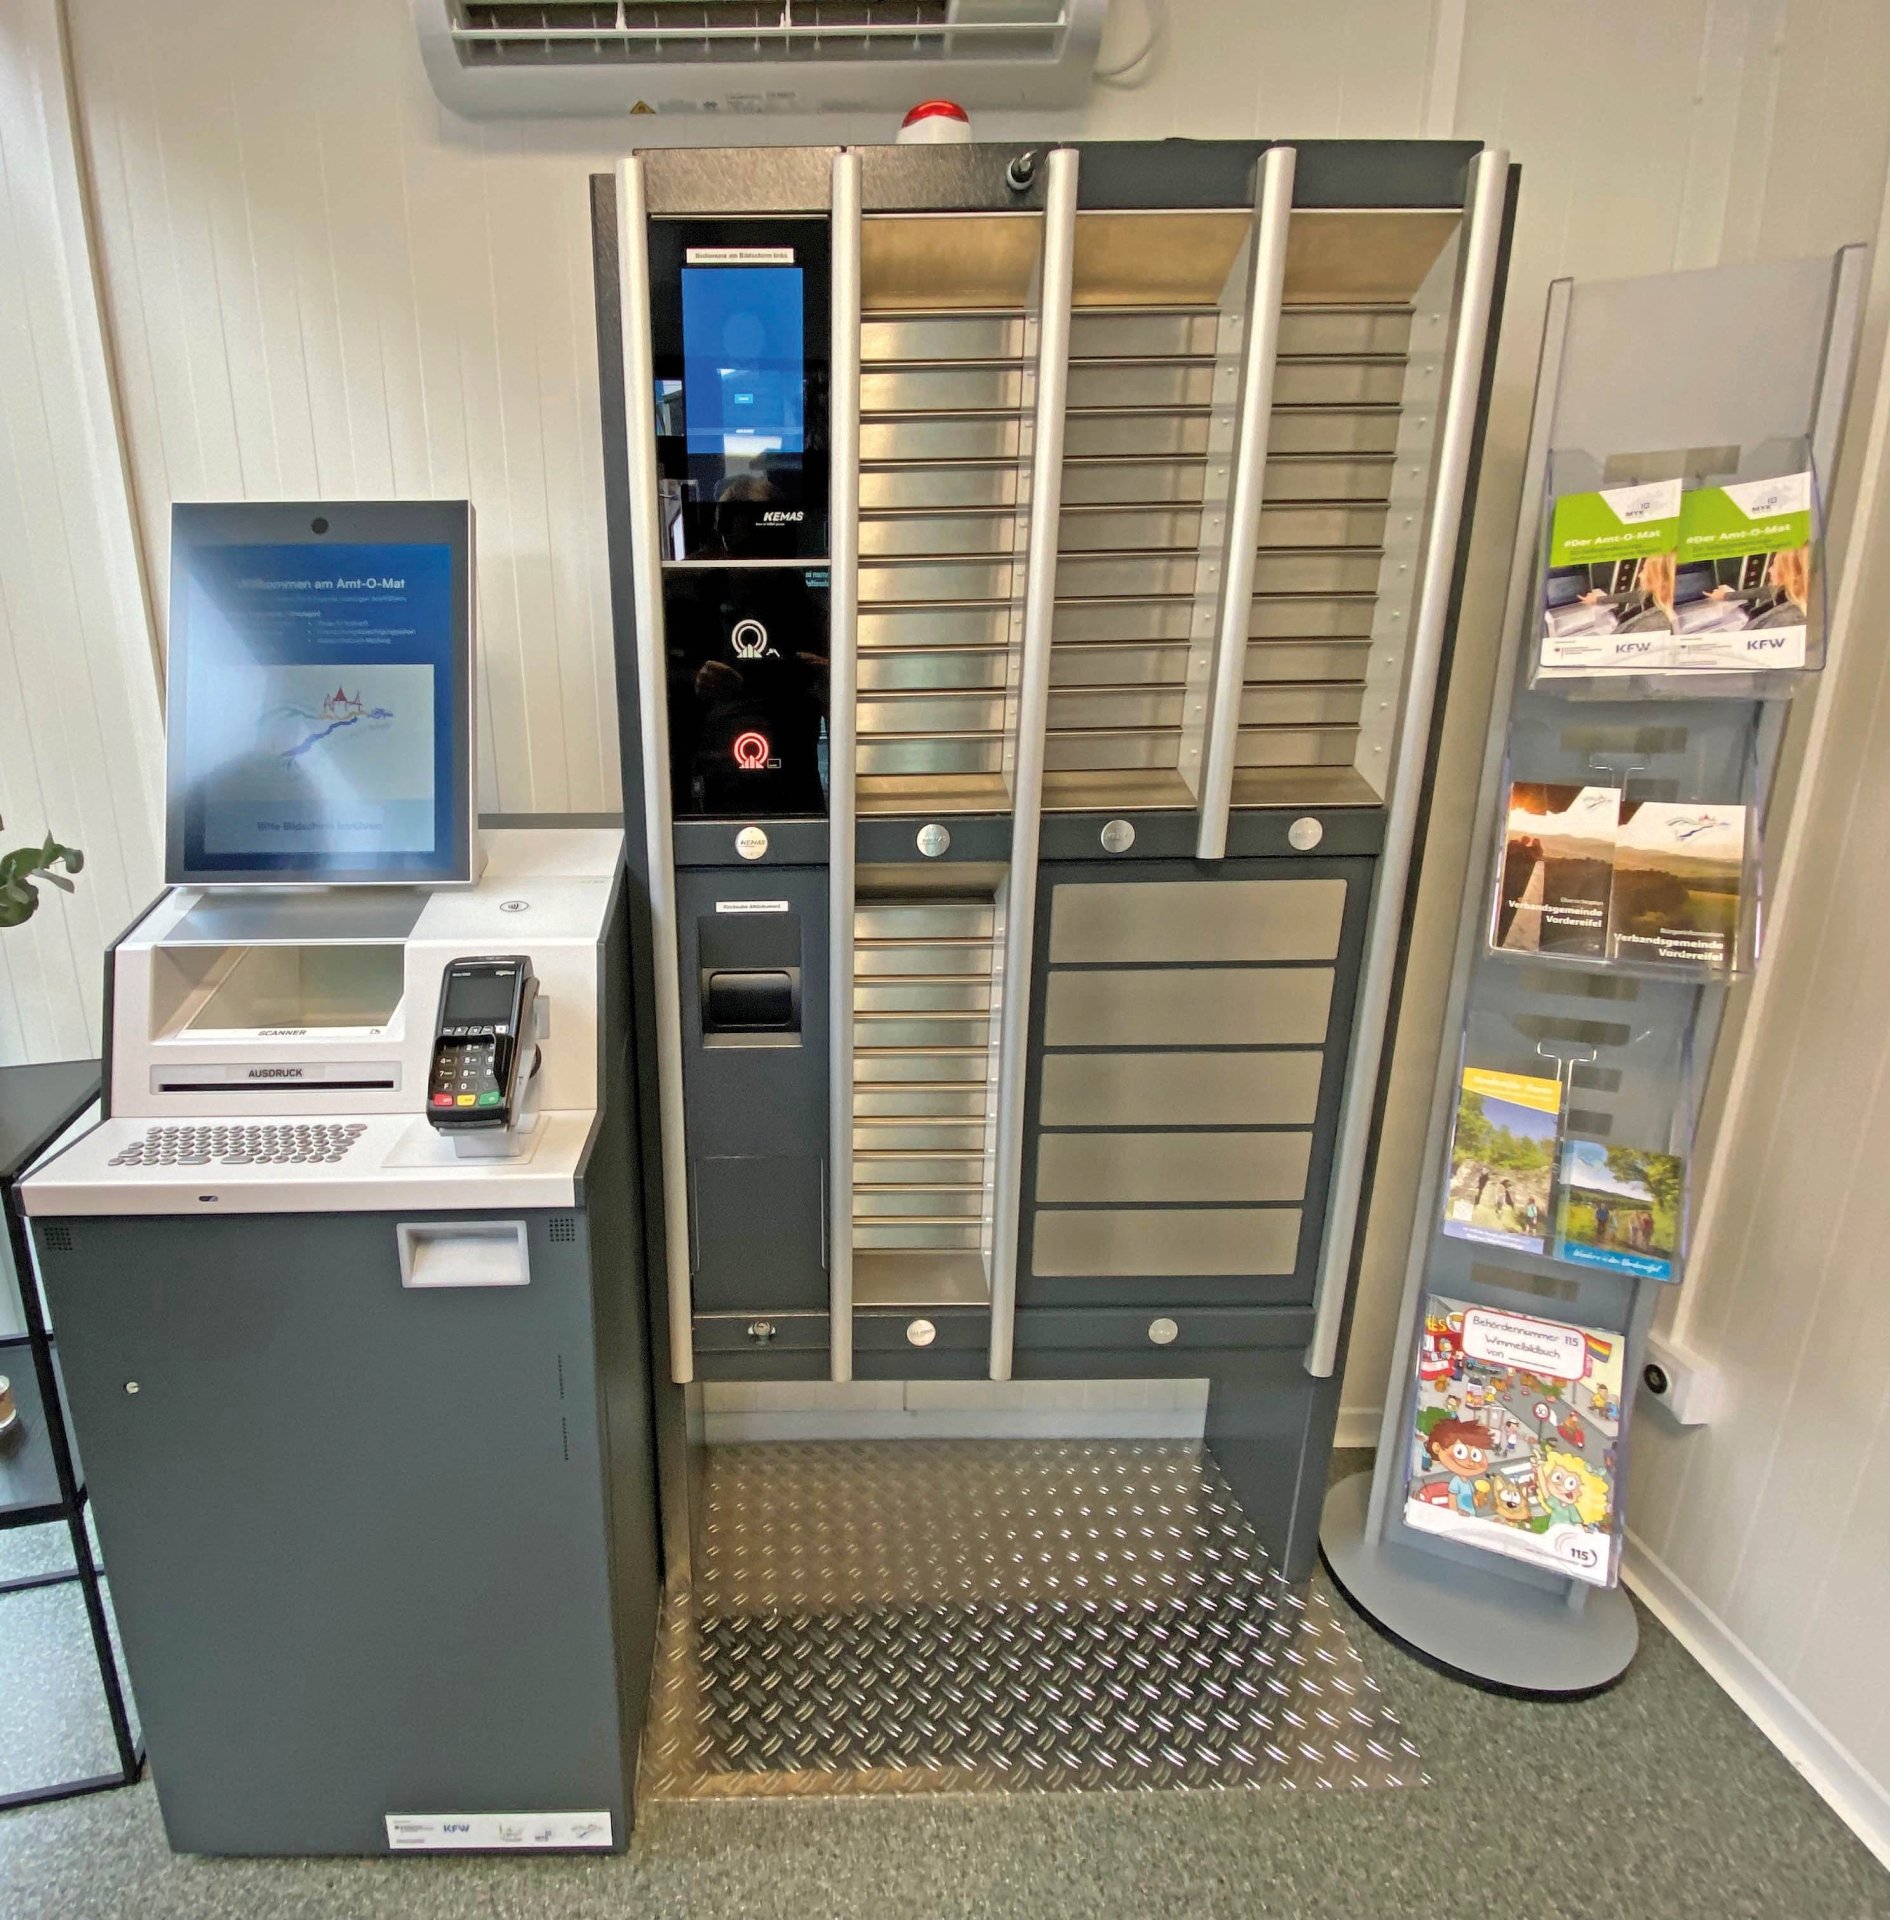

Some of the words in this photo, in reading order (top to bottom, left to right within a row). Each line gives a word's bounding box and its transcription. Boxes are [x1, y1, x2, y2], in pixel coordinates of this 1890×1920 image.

[763, 511, 805, 522] KEMAS
[1563, 539, 1593, 548] #Der
[1594, 529, 1662, 545] Amt-O-Mat
[1686, 535, 1717, 545] #Der
[1719, 524, 1791, 541] Amt-O-Mat
[314, 580, 333, 589] am
[336, 578, 406, 589] Amt-O-Mat
[1508, 900, 1603, 917] Verbandsgemeinde
[1546, 915, 1602, 928] Vordereifel
[1614, 933, 1724, 950] Verbandsgemeinde
[1658, 948, 1724, 961] Vordereifel
[248, 1068, 303, 1078] AUSDRUCK
[1472, 1315, 1560, 1342] Behördennummer
[1564, 1335, 1579, 1347] 115
[1484, 1334, 1561, 1360] Wimmelbildbuch
[1486, 1348, 1505, 1359] von
[1571, 1547, 1589, 1561] 115
